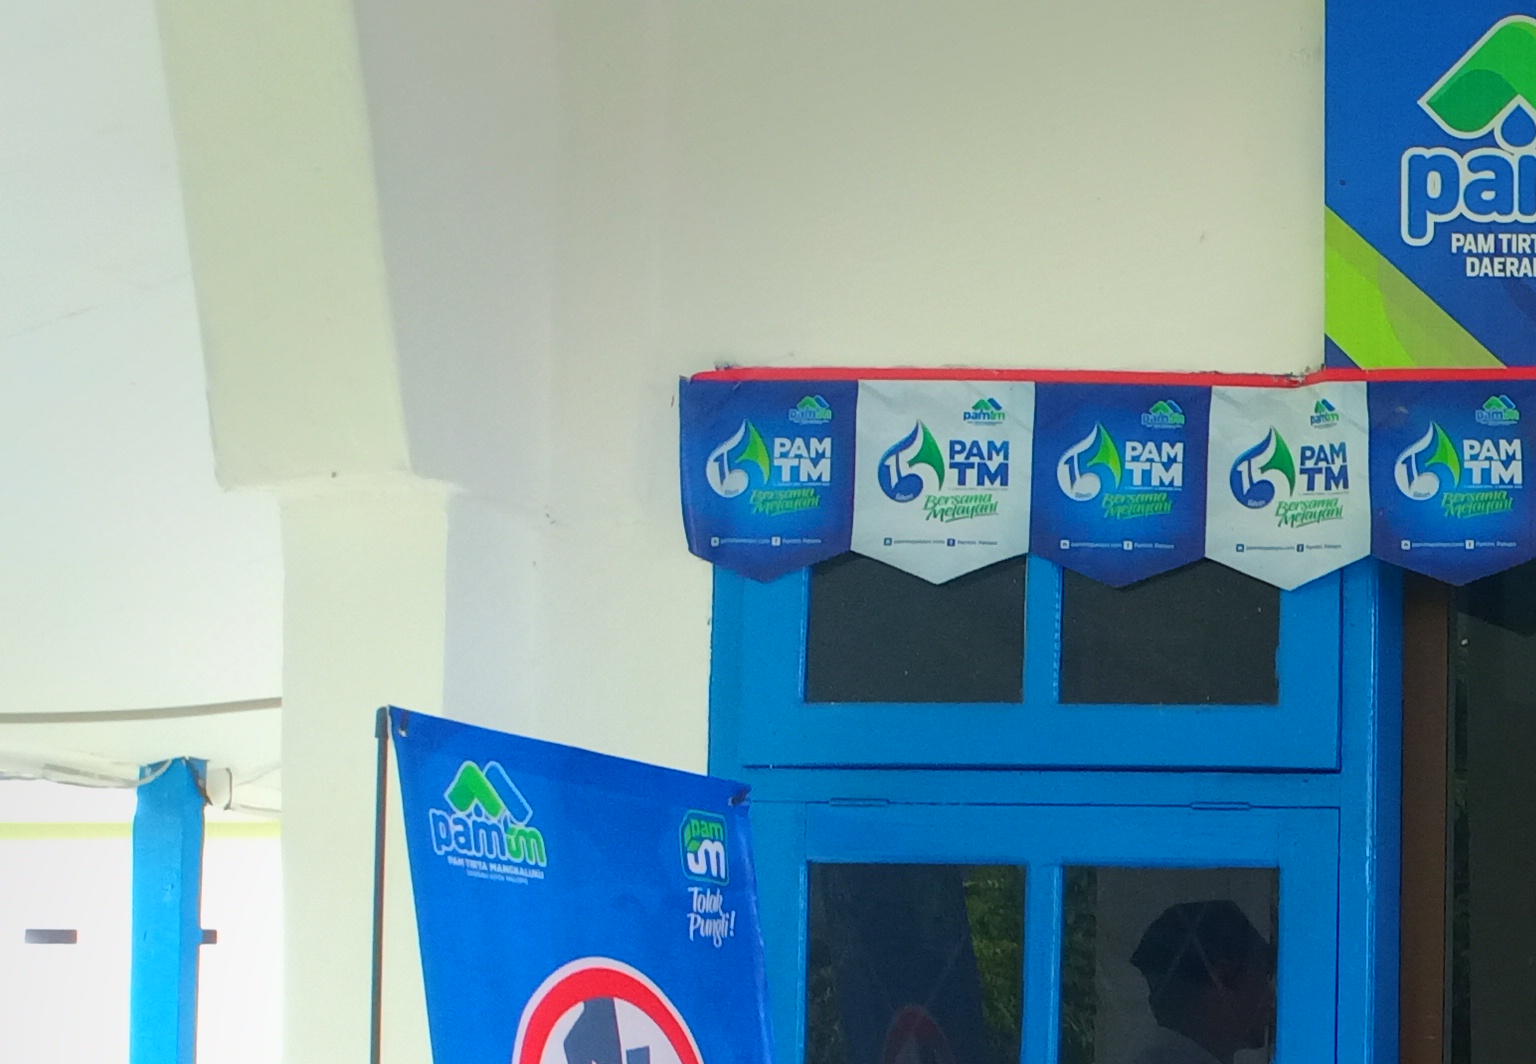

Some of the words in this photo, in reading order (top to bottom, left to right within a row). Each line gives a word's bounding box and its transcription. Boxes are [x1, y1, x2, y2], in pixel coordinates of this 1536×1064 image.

[1452, 234, 1494, 254] PAM
[774, 437, 832, 458] PAM
[950, 440, 1009, 461] PAM
[1300, 442, 1347, 466] PAM
[1463, 439, 1521, 461] PAM
[774, 458, 832, 483] TM
[950, 462, 1009, 486] TM
[1300, 467, 1349, 492] TM
[1464, 461, 1522, 485] TM
[923, 494, 993, 511] Bersama
[926, 502, 999, 523] Melayani
[1275, 498, 1339, 515] Bersama
[1278, 506, 1344, 527] Melayani
[688, 818, 724, 839] pam
[687, 887, 724, 917] Tolak
[687, 910, 735, 948] Pungli!
